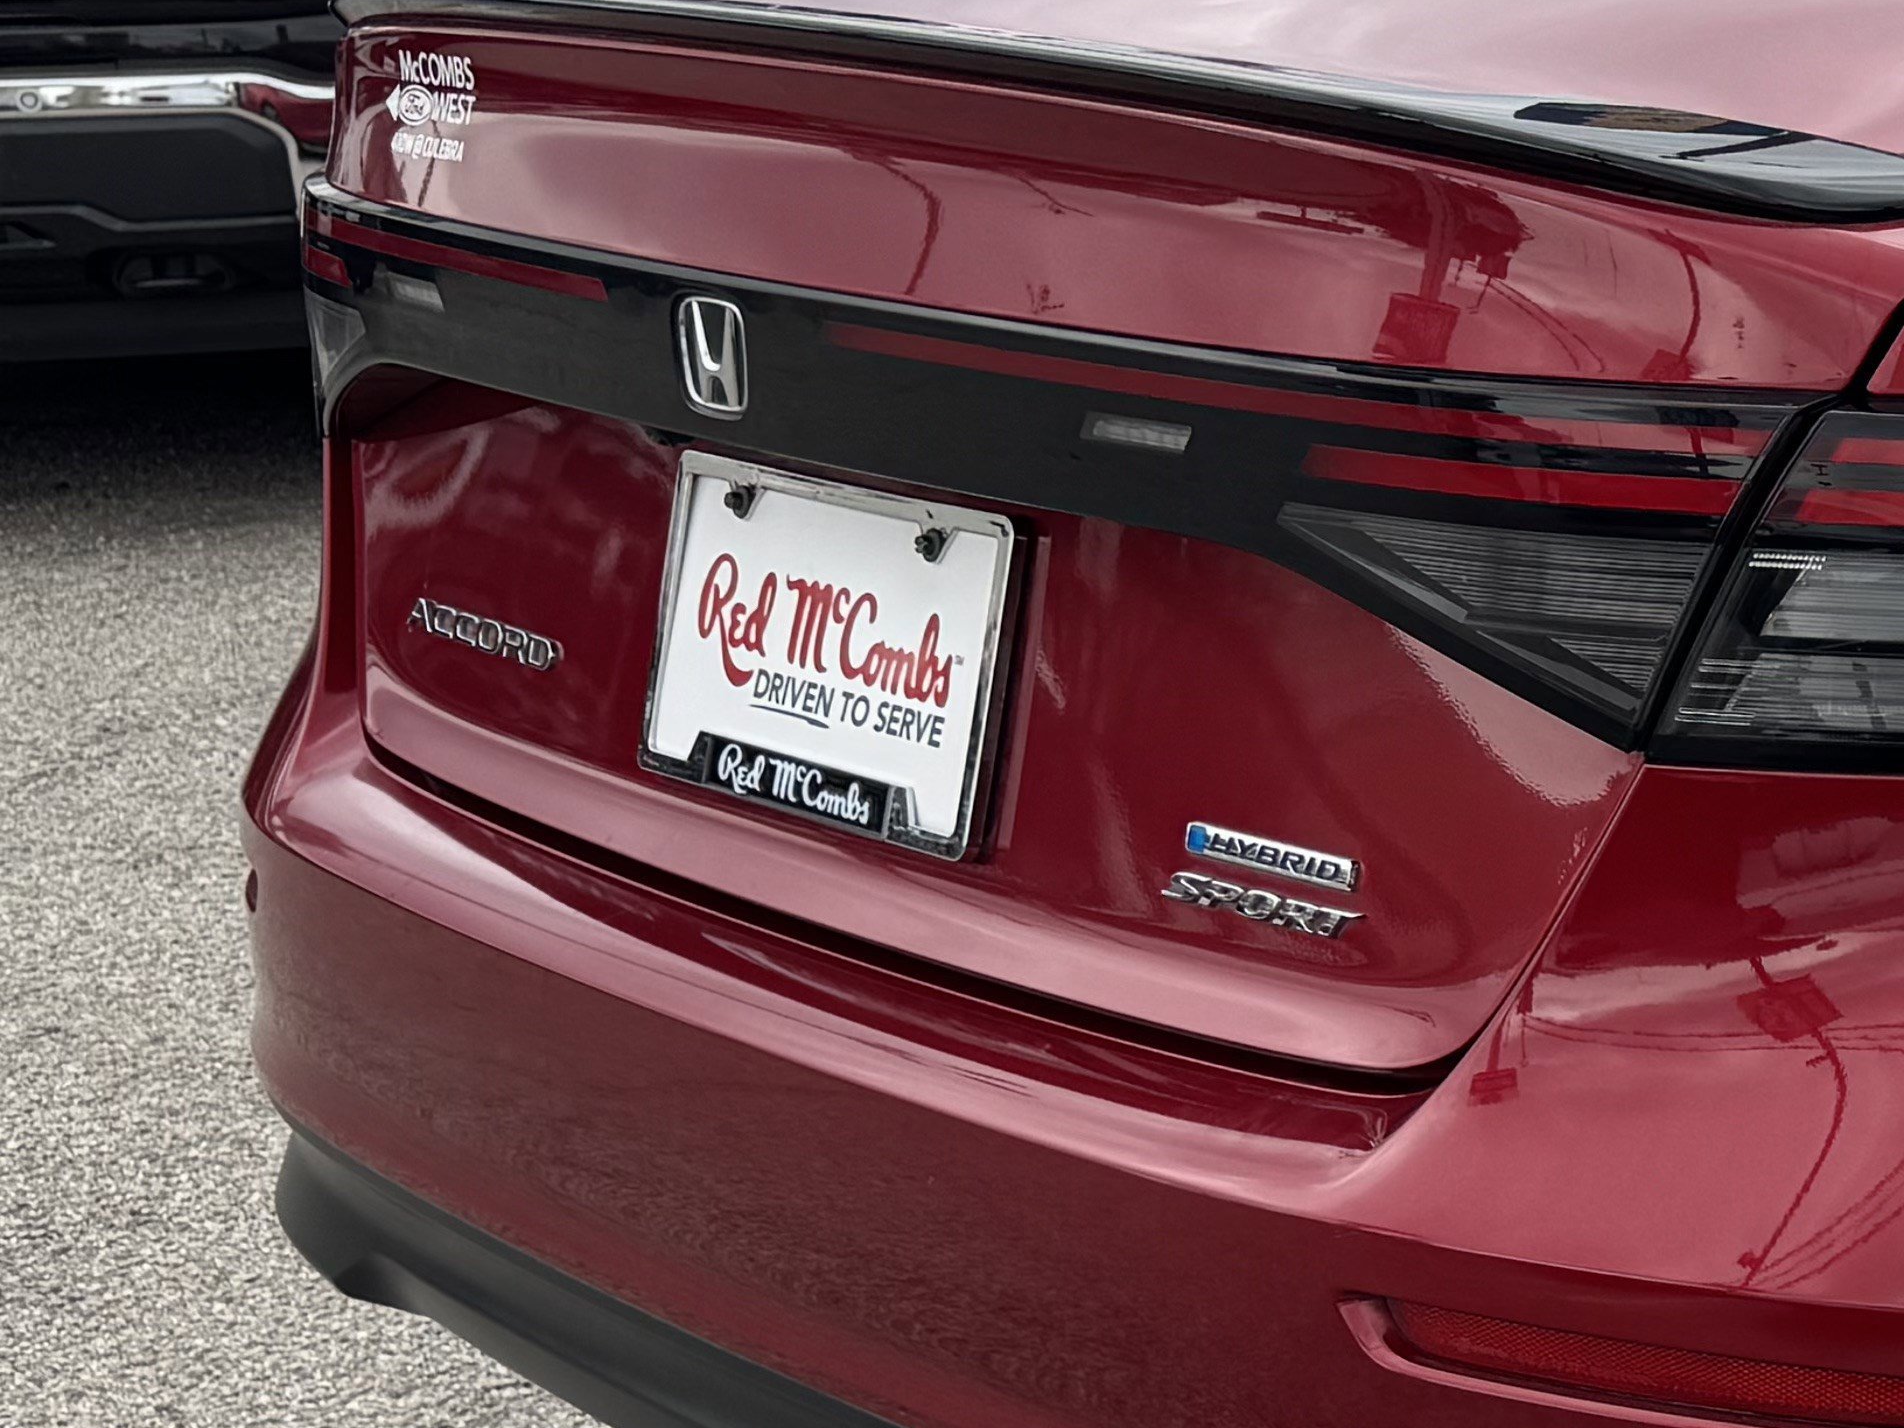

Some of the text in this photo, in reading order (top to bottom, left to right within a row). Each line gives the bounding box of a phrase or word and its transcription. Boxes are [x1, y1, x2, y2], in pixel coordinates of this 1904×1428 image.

[398, 49, 475, 91] McCOMBS
[431, 91, 476, 125] WEST
[406, 598, 564, 671] ACCORD
[698, 553, 953, 708] Red McCombs
[753, 668, 946, 748] DRIVEN TO SERVE
[717, 744, 870, 825] Red McCombs
[1211, 833, 1344, 882] HYBRID
[1161, 872, 1367, 939] SPORT
